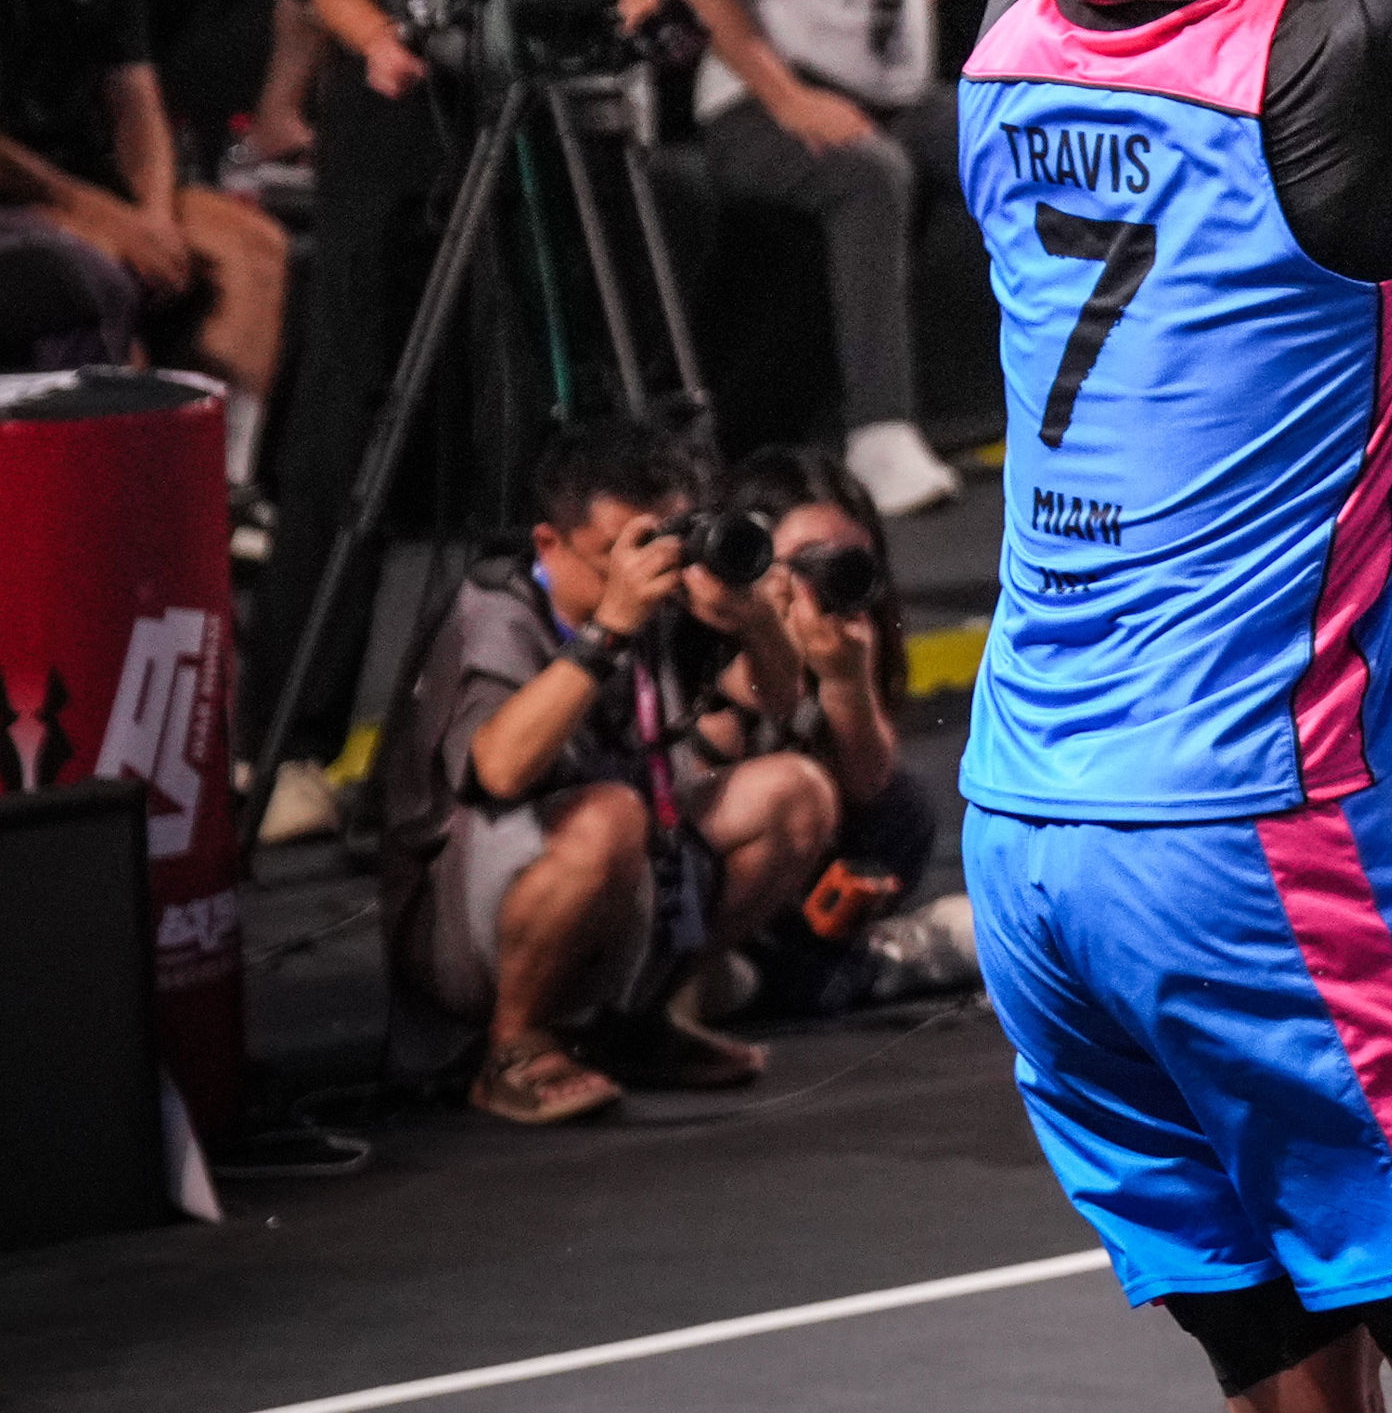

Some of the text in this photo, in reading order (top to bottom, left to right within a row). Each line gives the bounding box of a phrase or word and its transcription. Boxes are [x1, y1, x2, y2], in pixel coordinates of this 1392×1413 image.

[1001, 122, 1151, 193] TRAVIS
[1034, 201, 1156, 448] 7
[1032, 486, 1122, 546] MIAMI
